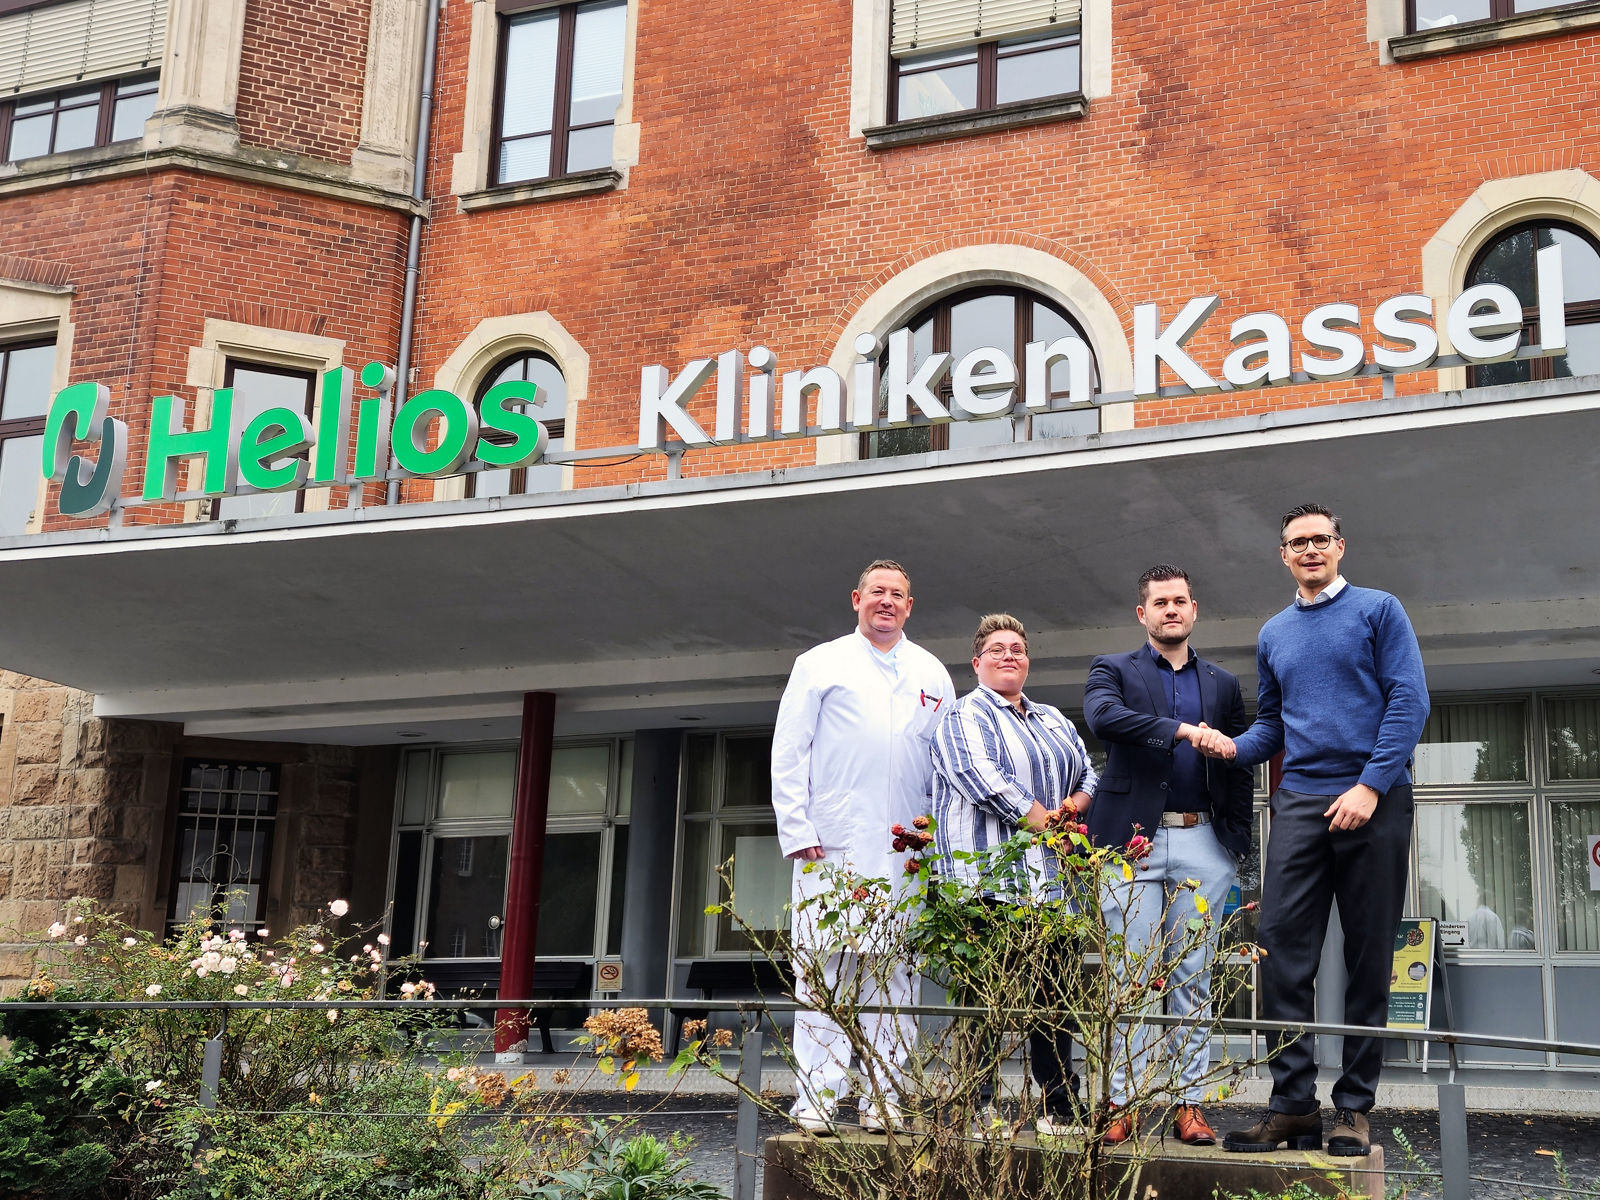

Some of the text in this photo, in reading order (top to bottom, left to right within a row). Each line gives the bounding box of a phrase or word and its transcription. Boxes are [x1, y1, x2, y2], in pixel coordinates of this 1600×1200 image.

[143, 243, 1567, 500] Helios Kliniken Kassel
